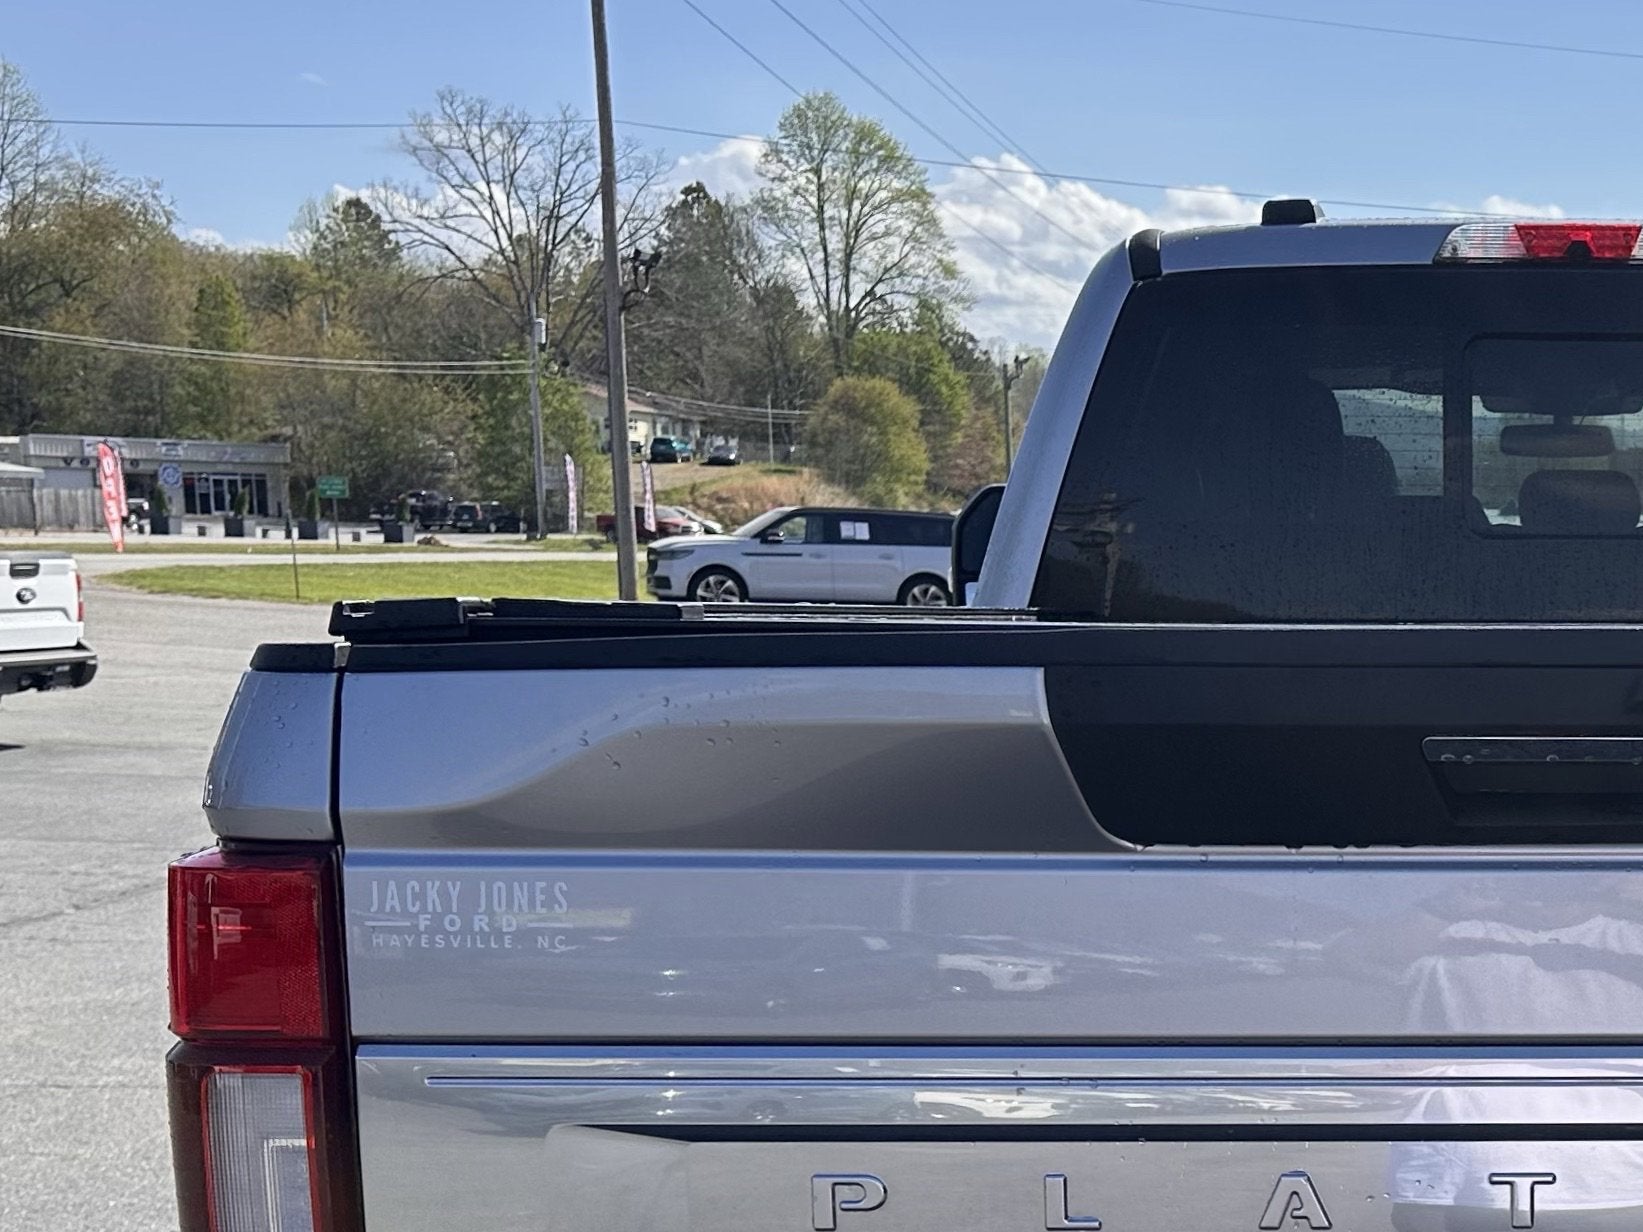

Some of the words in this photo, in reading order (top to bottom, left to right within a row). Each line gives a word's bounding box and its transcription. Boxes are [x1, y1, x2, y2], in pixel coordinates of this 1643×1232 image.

[370, 880, 462, 913] JACKY
[477, 881, 569, 914] JONES
[417, 914, 519, 933] FORD
[537, 936, 567, 949] NC
